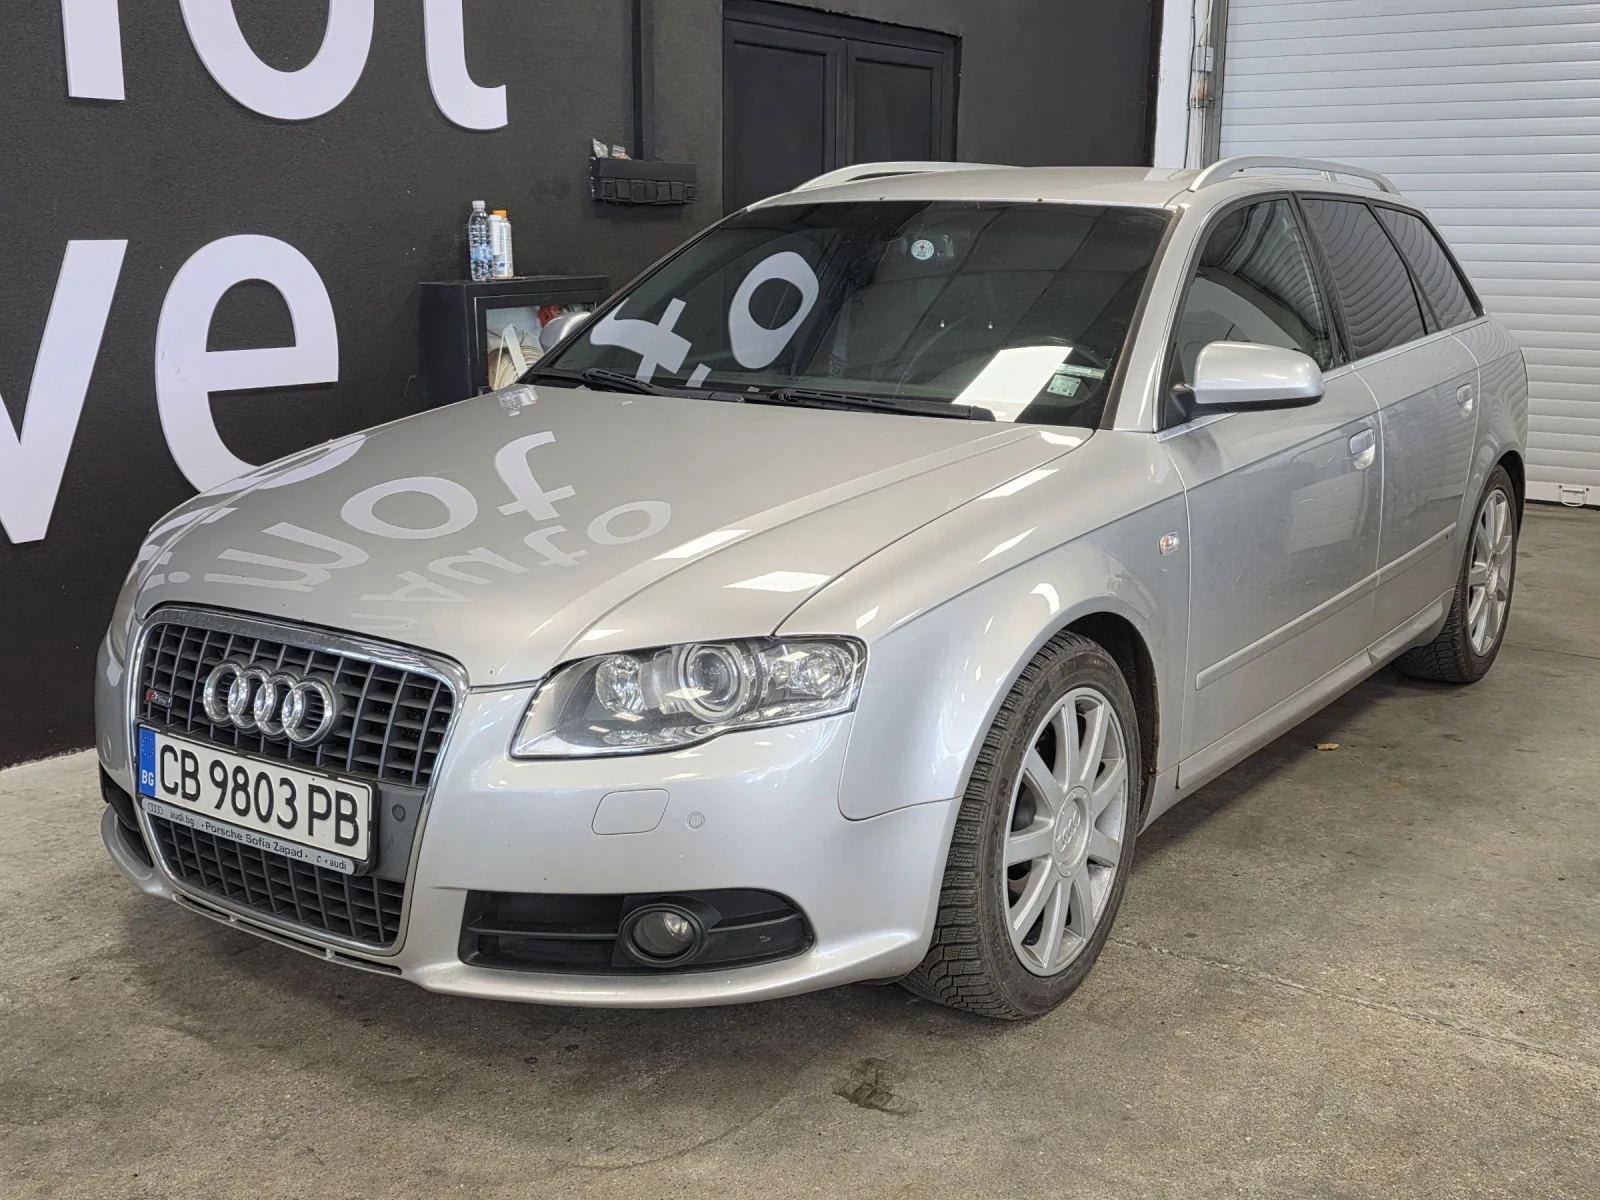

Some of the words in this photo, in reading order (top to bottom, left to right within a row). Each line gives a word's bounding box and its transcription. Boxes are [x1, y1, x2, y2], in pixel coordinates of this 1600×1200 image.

[142, 770, 154, 786] BG
[160, 744, 201, 802] CB
[209, 759, 298, 829] 9803
[308, 783, 359, 847] PB
[170, 811, 195, 827] audi.bg
[205, 822, 243, 841] Porsche
[245, 833, 271, 849] Sofia
[273, 842, 303, 858] Zapad
